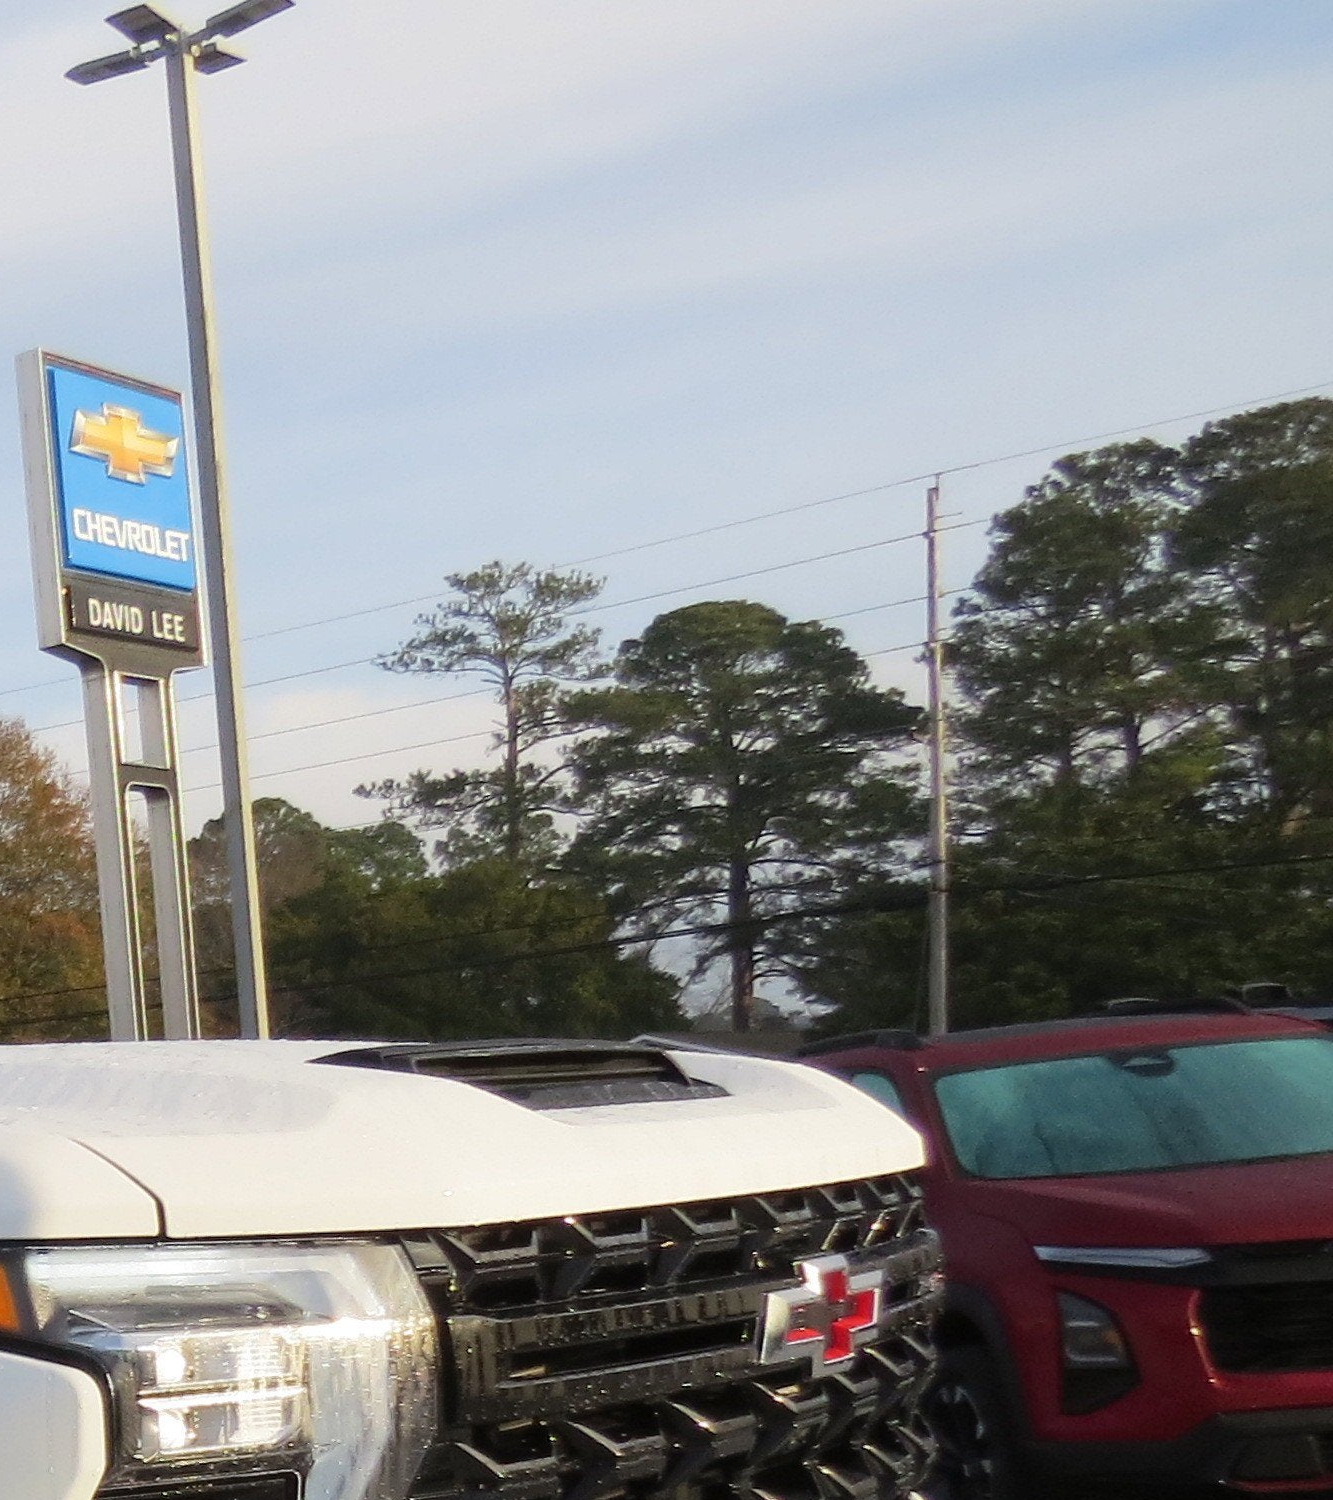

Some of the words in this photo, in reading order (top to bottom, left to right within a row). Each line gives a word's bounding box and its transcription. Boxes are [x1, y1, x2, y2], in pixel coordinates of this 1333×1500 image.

[72, 509, 190, 562] CHEVROLET
[88, 598, 144, 635] DAVID
[152, 611, 186, 643] LEE
